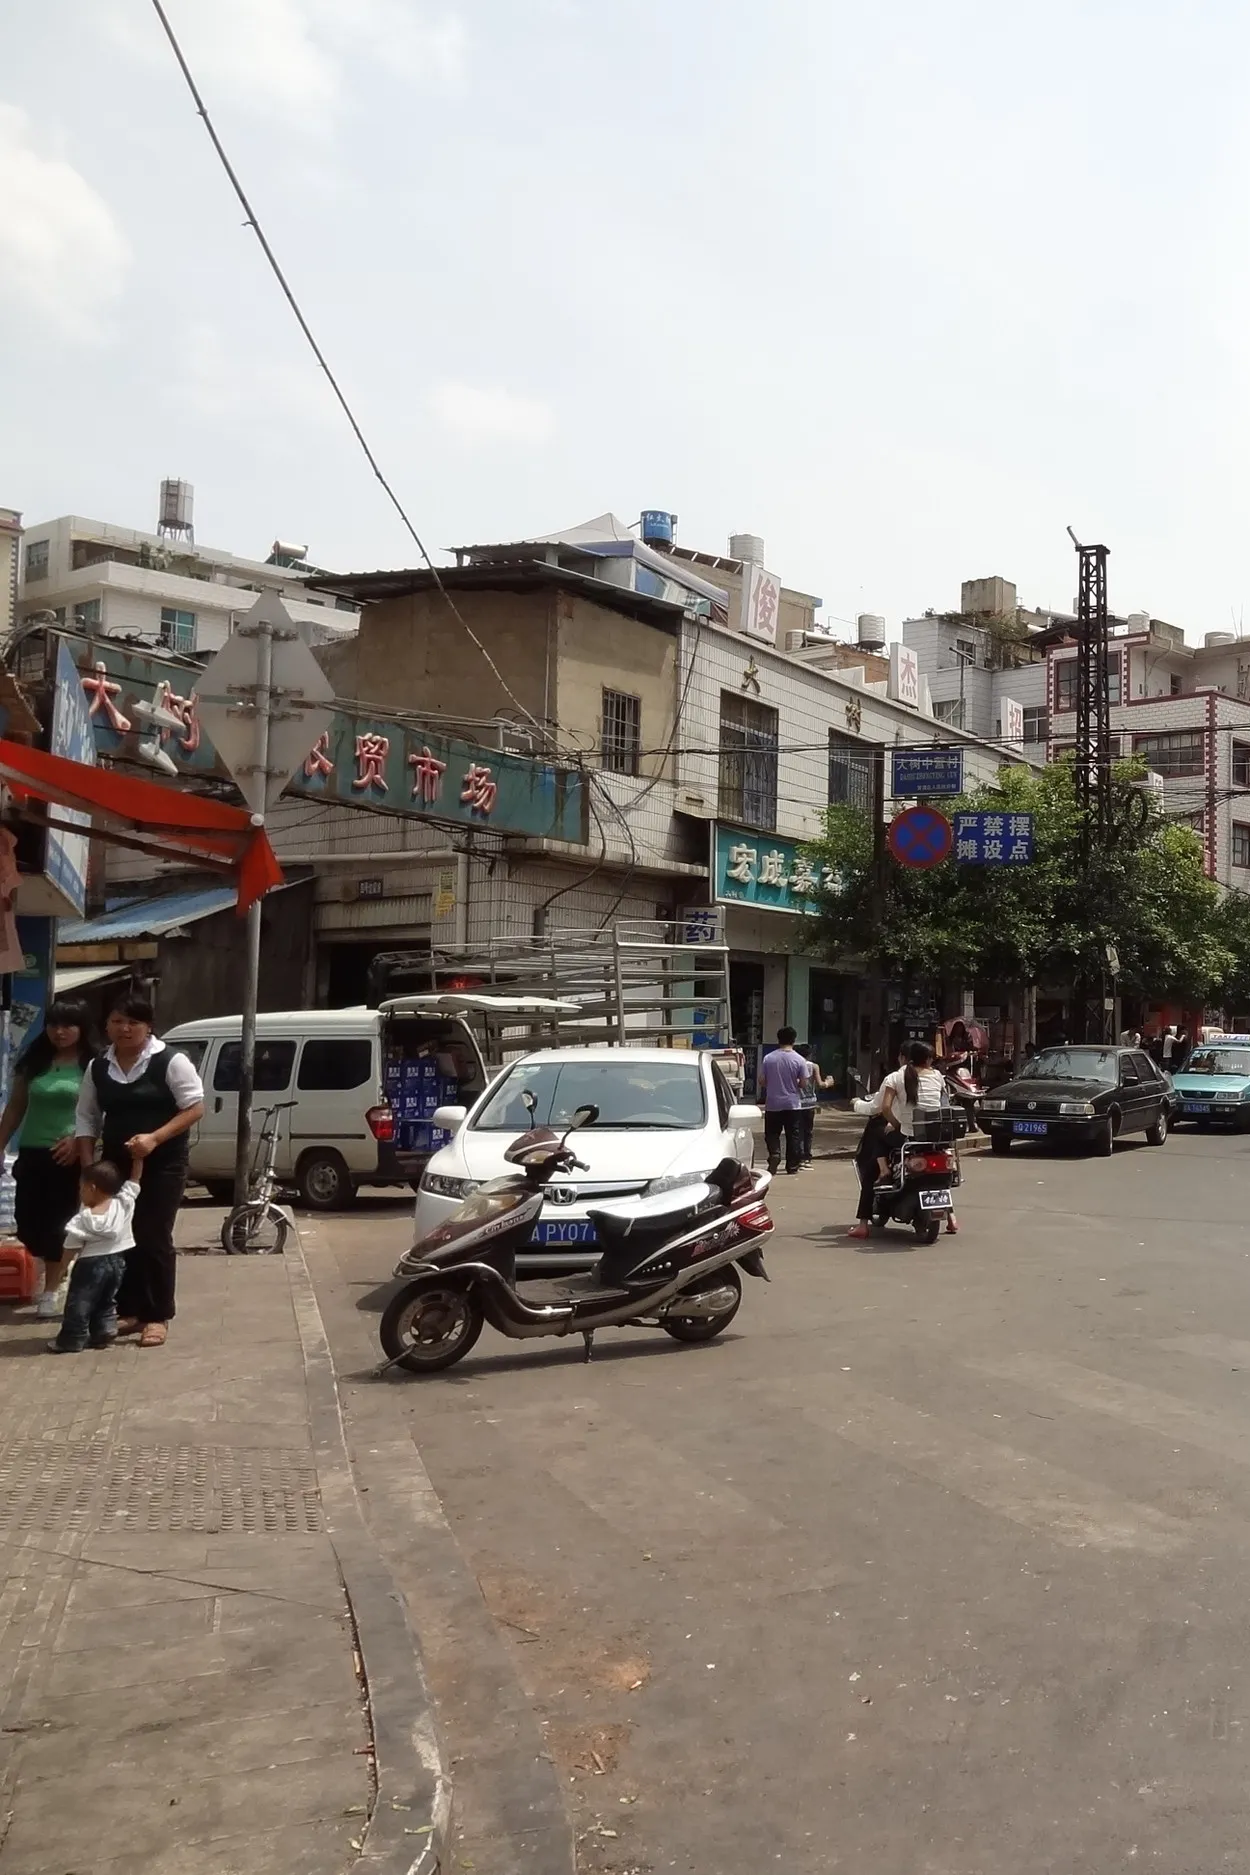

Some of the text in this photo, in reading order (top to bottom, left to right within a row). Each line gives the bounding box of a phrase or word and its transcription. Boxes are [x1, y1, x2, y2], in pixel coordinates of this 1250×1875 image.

[752, 573, 777, 635] 俊
[901, 653, 917, 700] 杰
[957, 816, 1030, 837] 严禁摆
[957, 840, 1029, 860] 摊设点
[685, 911, 718, 943] 药
